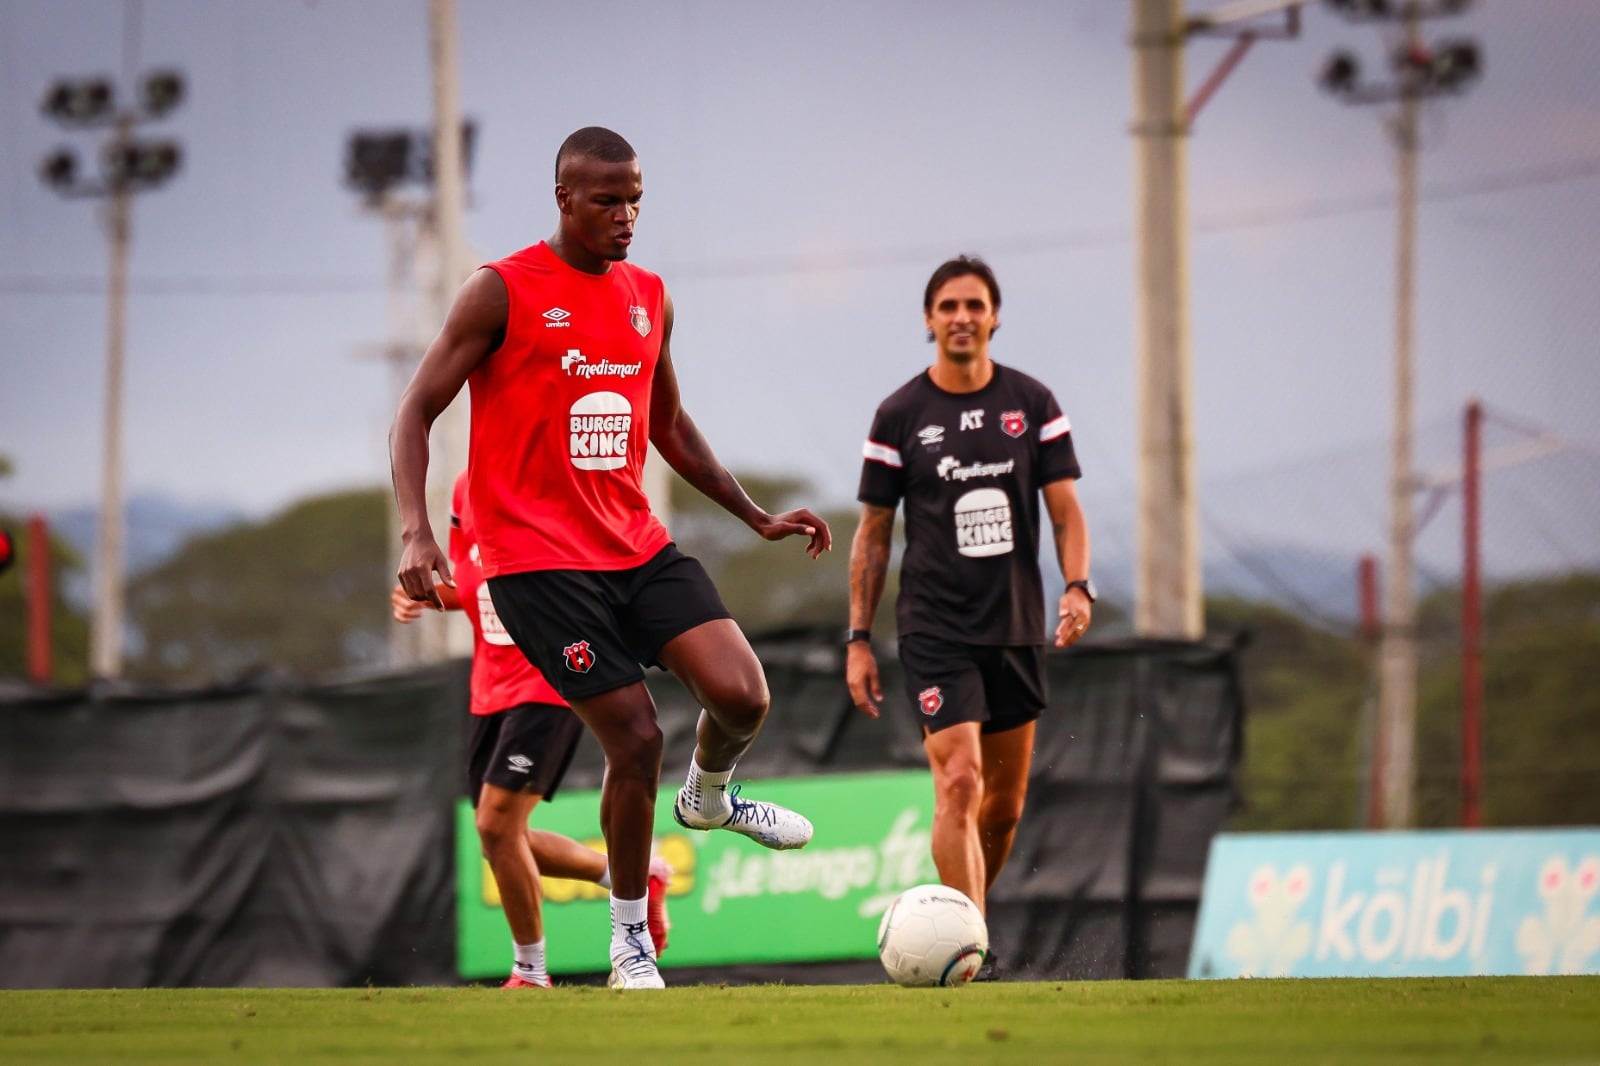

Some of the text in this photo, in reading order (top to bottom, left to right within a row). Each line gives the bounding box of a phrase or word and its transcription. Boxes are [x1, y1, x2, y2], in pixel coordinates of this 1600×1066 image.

[545, 320, 570, 328] umbro
[576, 359, 642, 379] medismart
[570, 415, 632, 434] BURGER
[959, 408, 985, 432] AT
[570, 432, 629, 457] KING
[957, 520, 1013, 548] KING
